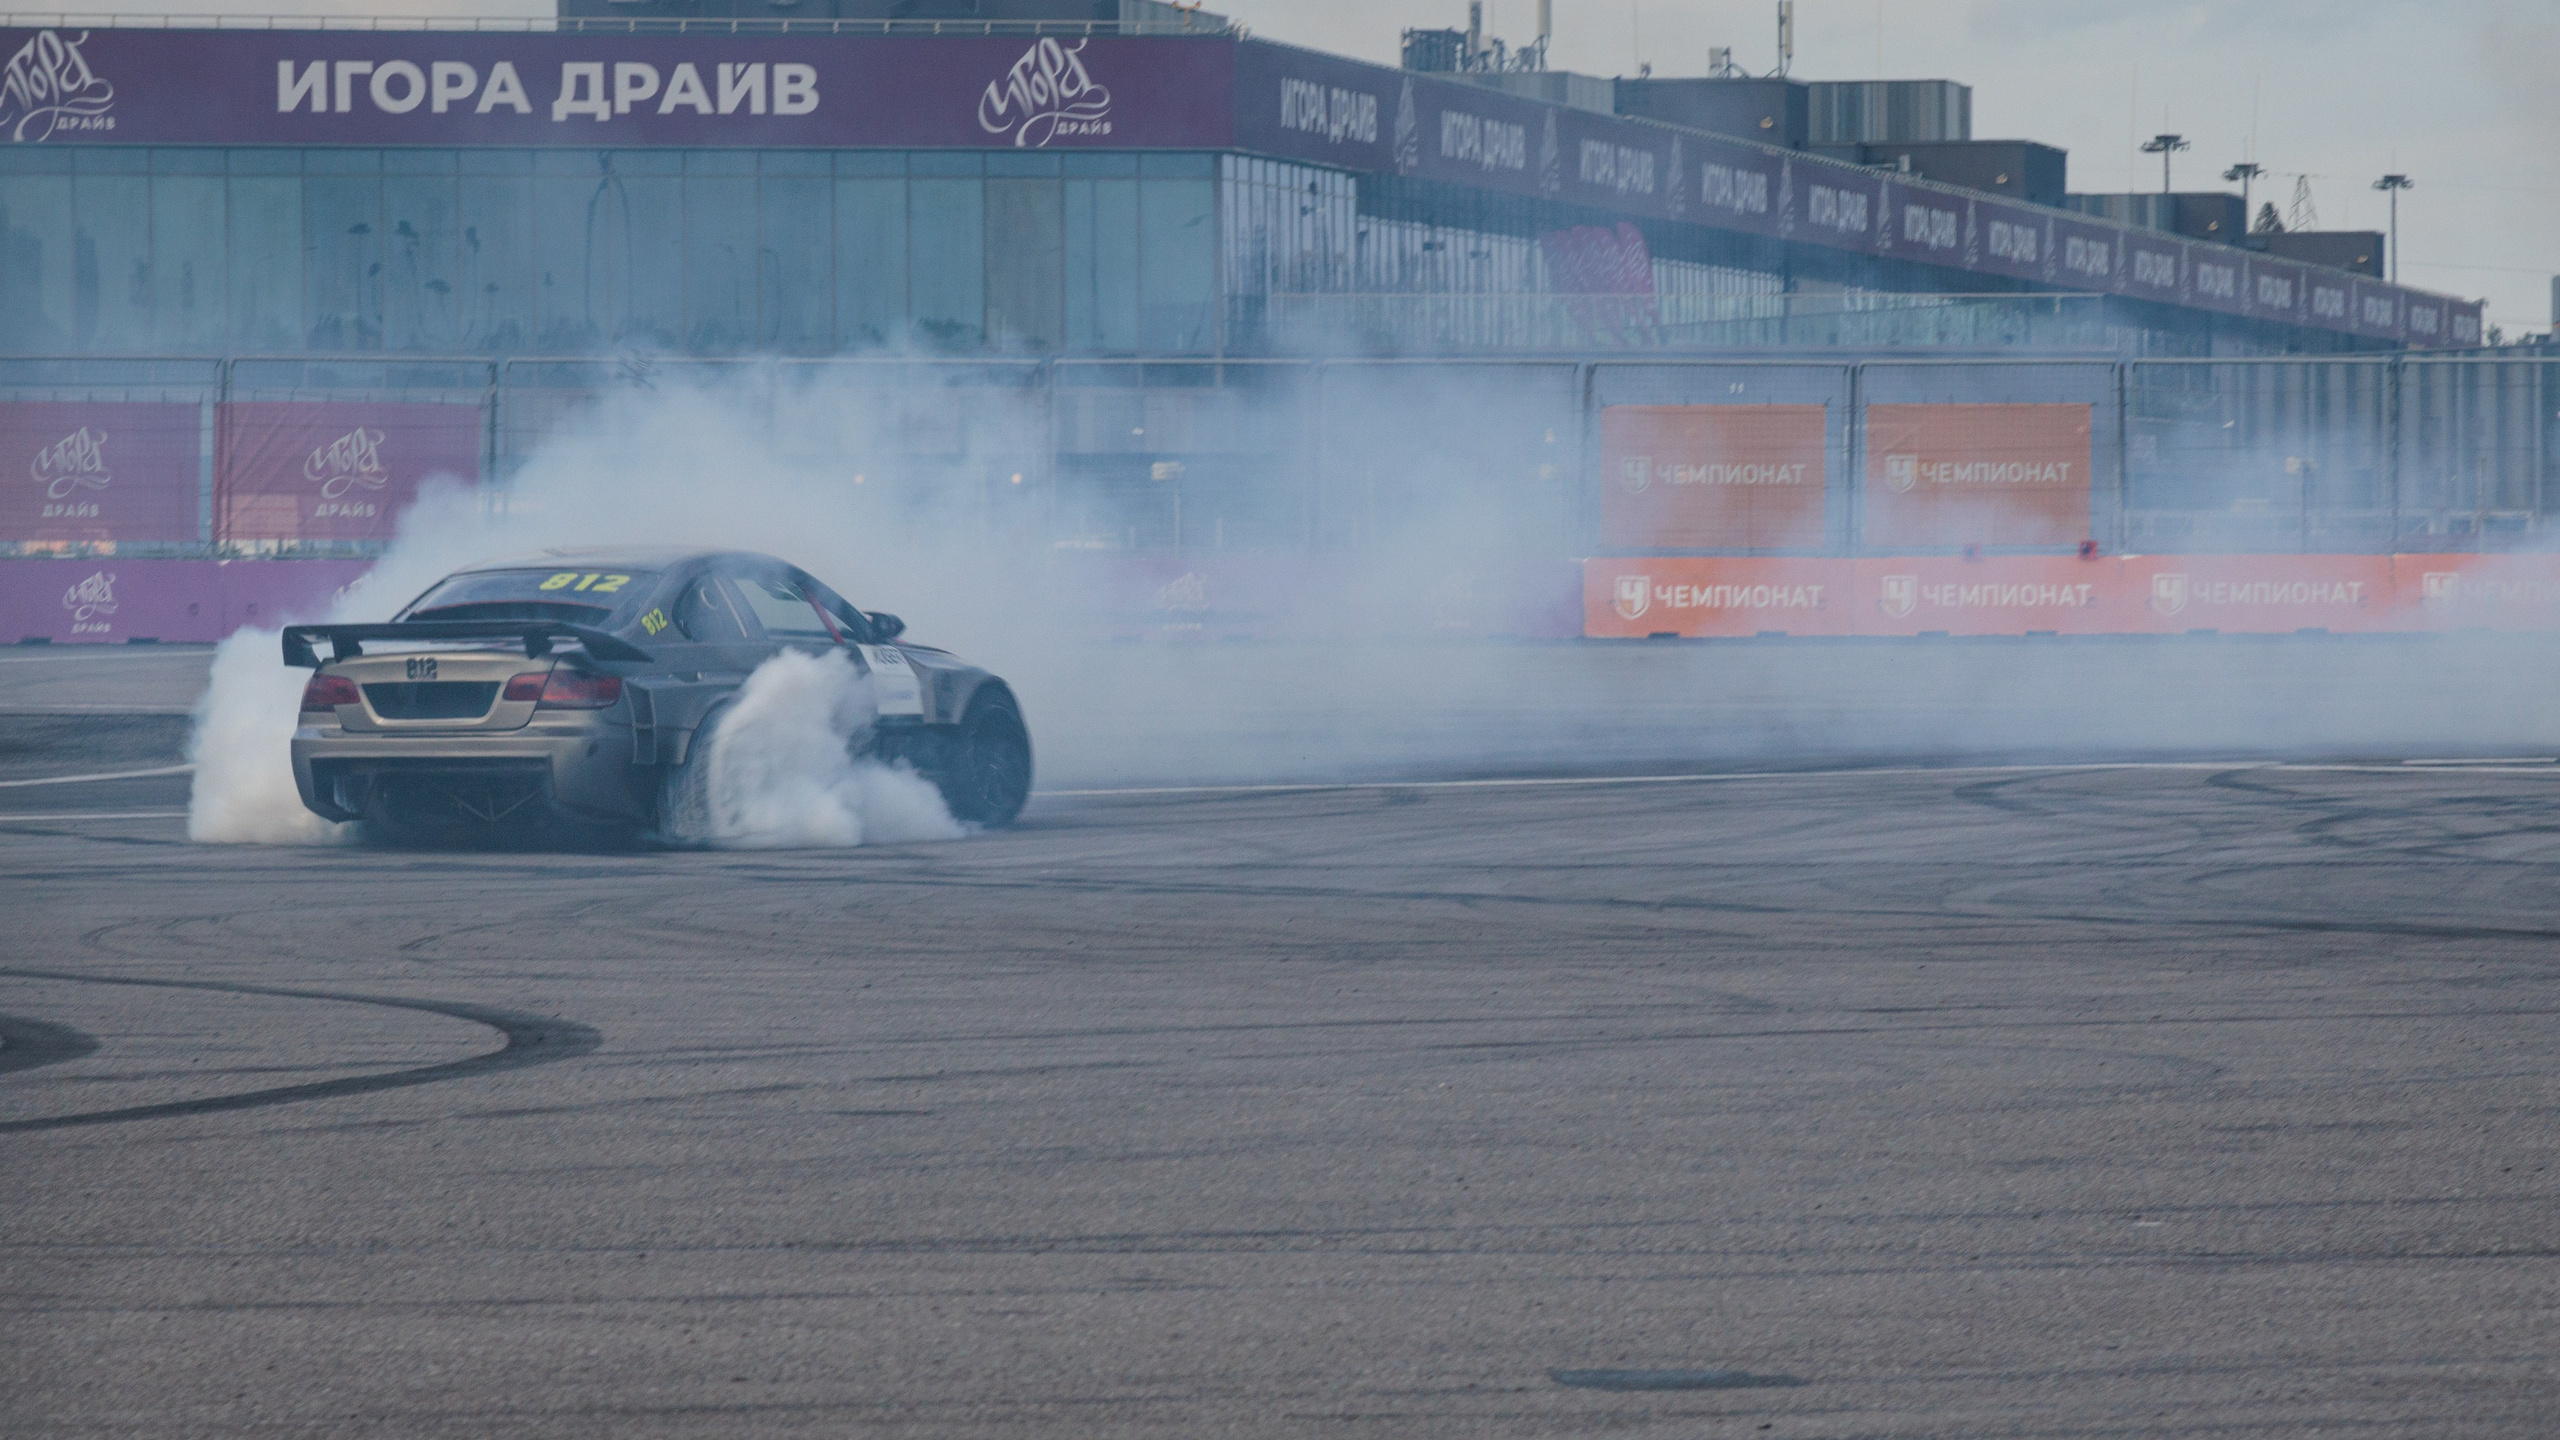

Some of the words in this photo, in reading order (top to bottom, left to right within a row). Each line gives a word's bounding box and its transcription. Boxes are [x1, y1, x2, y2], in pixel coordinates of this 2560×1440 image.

[277, 60, 533, 114] ИГОРА
[552, 61, 820, 122] ДРАЙВ
[56, 115, 116, 130] ДРАЙВ
[1055, 119, 1112, 135] ДРАЙВ
[1656, 462, 1807, 486] ЧЕМПИОНАТ
[1920, 461, 2073, 484] ЧЕМПИОНАТ
[41, 501, 100, 518] ДРАЙВ
[314, 501, 376, 518] ДРАЙВ
[539, 572, 631, 593] 812
[2192, 580, 2365, 605] ЧЕМПИОНАТ
[1655, 584, 1825, 609] ЧЕМПИОНАТ
[1922, 582, 2094, 608] ЧЕМПИОНАТ
[641, 607, 668, 636] 812
[406, 656, 438, 680] 812
